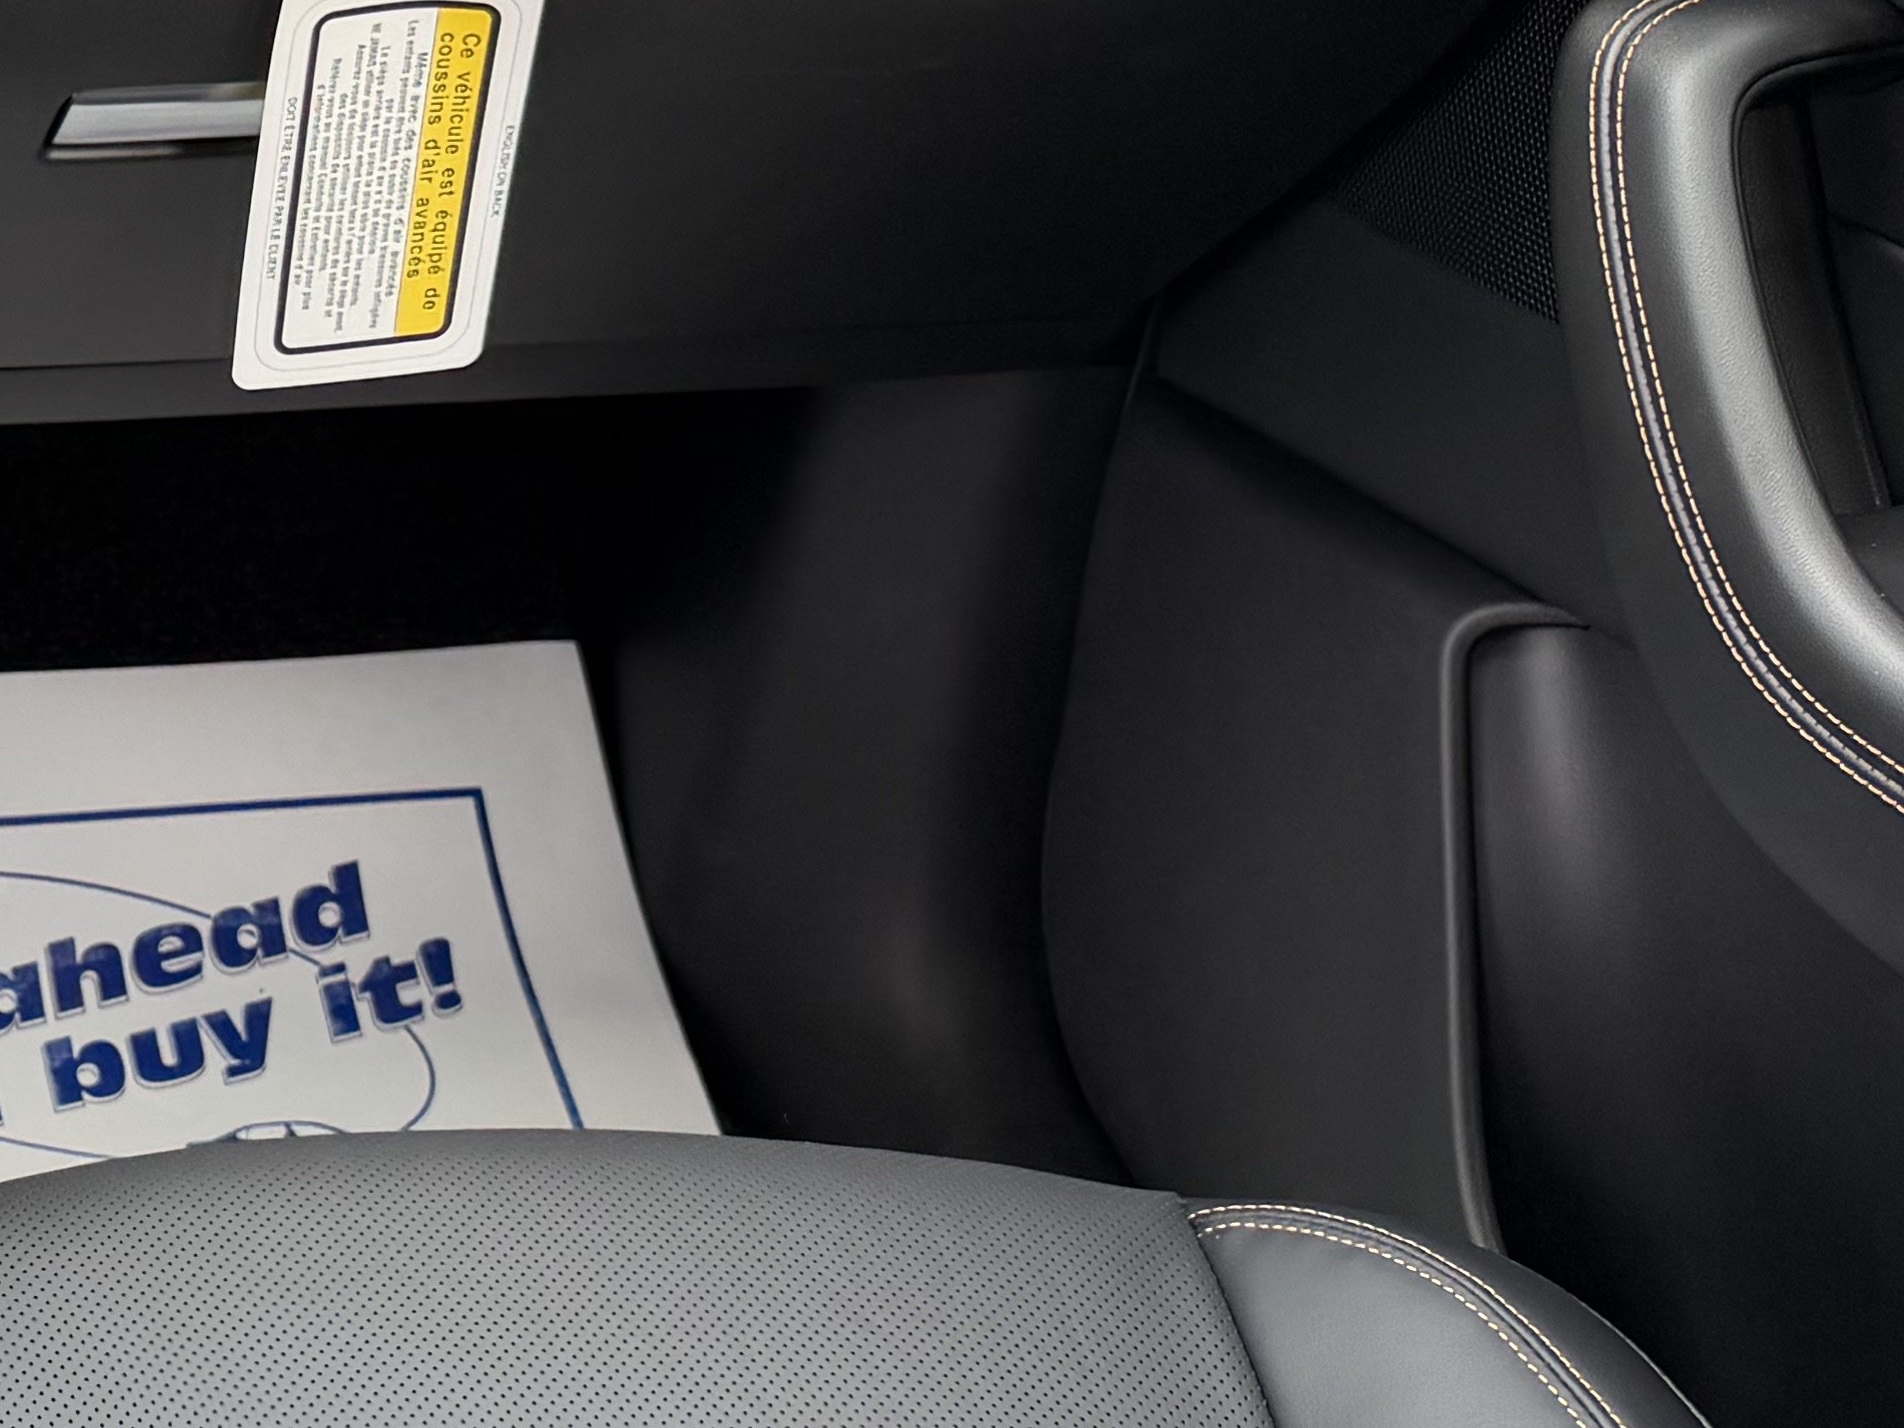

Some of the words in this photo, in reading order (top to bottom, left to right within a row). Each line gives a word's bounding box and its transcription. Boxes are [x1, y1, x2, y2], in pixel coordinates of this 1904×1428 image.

[426, 32, 456, 124] coussins
[457, 33, 481, 58] Ce
[443, 71, 473, 155] véhicule
[418, 138, 442, 184] d'air
[437, 167, 458, 196] est
[405, 197, 431, 278] avancés
[422, 208, 453, 275] équipé
[43, 997, 275, 1112] buy
[319, 936, 466, 1043] it!
